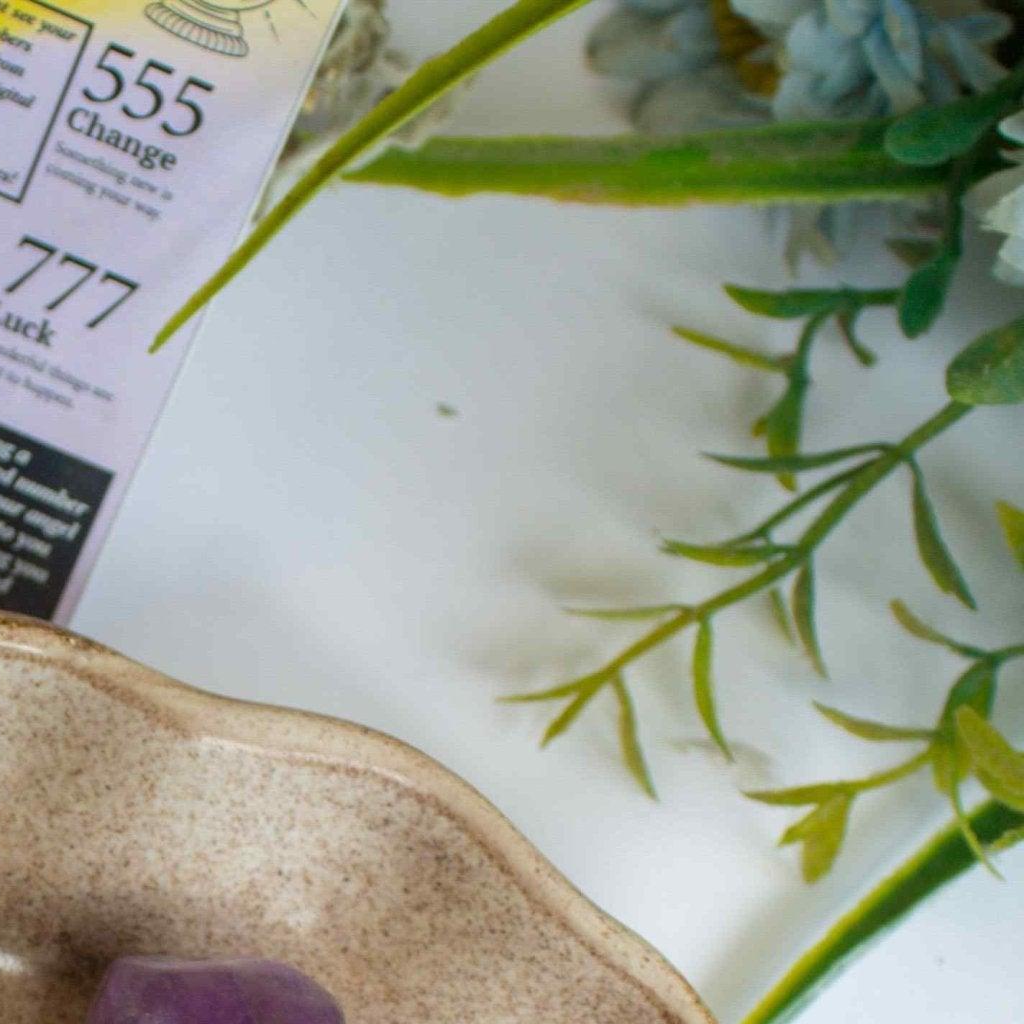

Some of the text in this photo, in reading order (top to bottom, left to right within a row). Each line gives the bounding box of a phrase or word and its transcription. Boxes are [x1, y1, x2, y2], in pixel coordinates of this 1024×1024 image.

[82, 43, 214, 136] 555
[66, 107, 175, 169] Change
[6, 237, 140, 328] 777
